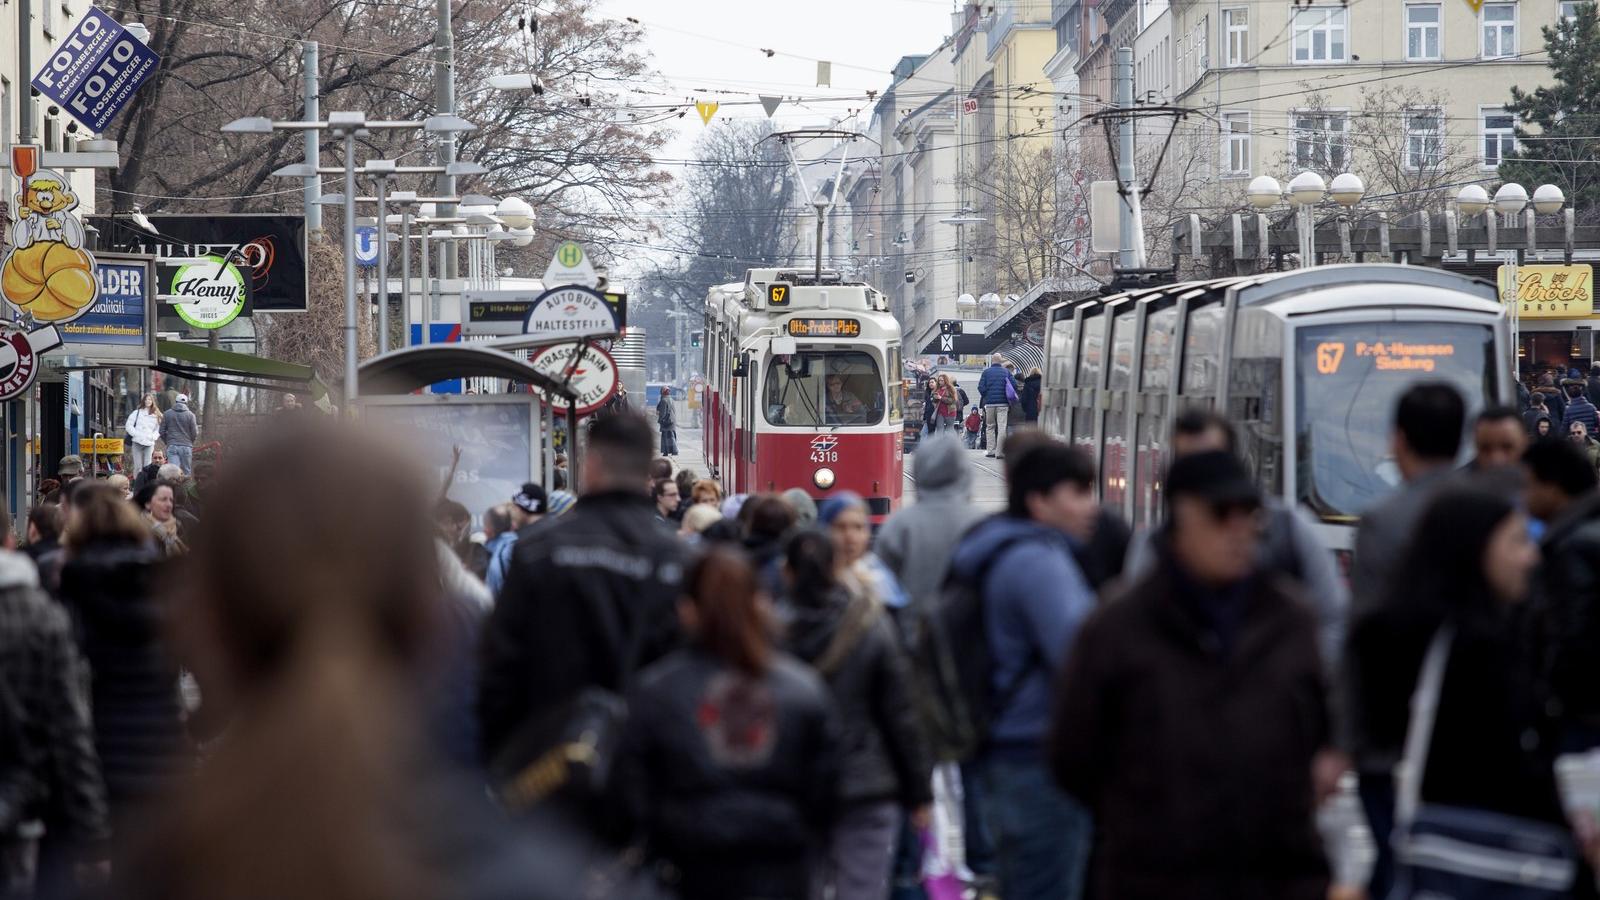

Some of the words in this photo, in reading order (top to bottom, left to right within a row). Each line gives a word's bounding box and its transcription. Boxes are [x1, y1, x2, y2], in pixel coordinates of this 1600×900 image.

[38, 16, 101, 88] FOTO
[56, 28, 107, 90] ROSENBERGER
[60, 29, 118, 100] SOFORT-FOTO-SERVICE
[71, 40, 135, 115] FOTO
[91, 55, 142, 117] ROSENBERGER
[96, 58, 154, 128] SOFORT-FOTO-SERVICE
[964, 100, 977, 112] 50
[355, 231, 379, 261] U
[565, 247, 576, 263] H
[98, 268, 142, 296] LDER
[772, 287, 785, 302] 67
[1502, 271, 1589, 302] Ströck
[545, 292, 599, 311] AUTOBUS
[1524, 303, 1569, 311] BROT
[64, 323, 86, 334] Sofort
[789, 319, 859, 334] Otto-Probst-Platz
[537, 347, 609, 373] STRASSBAHN
[1317, 342, 1345, 373] 67
[0, 354, 31, 395] AFIK
[810, 451, 838, 462] 4318
